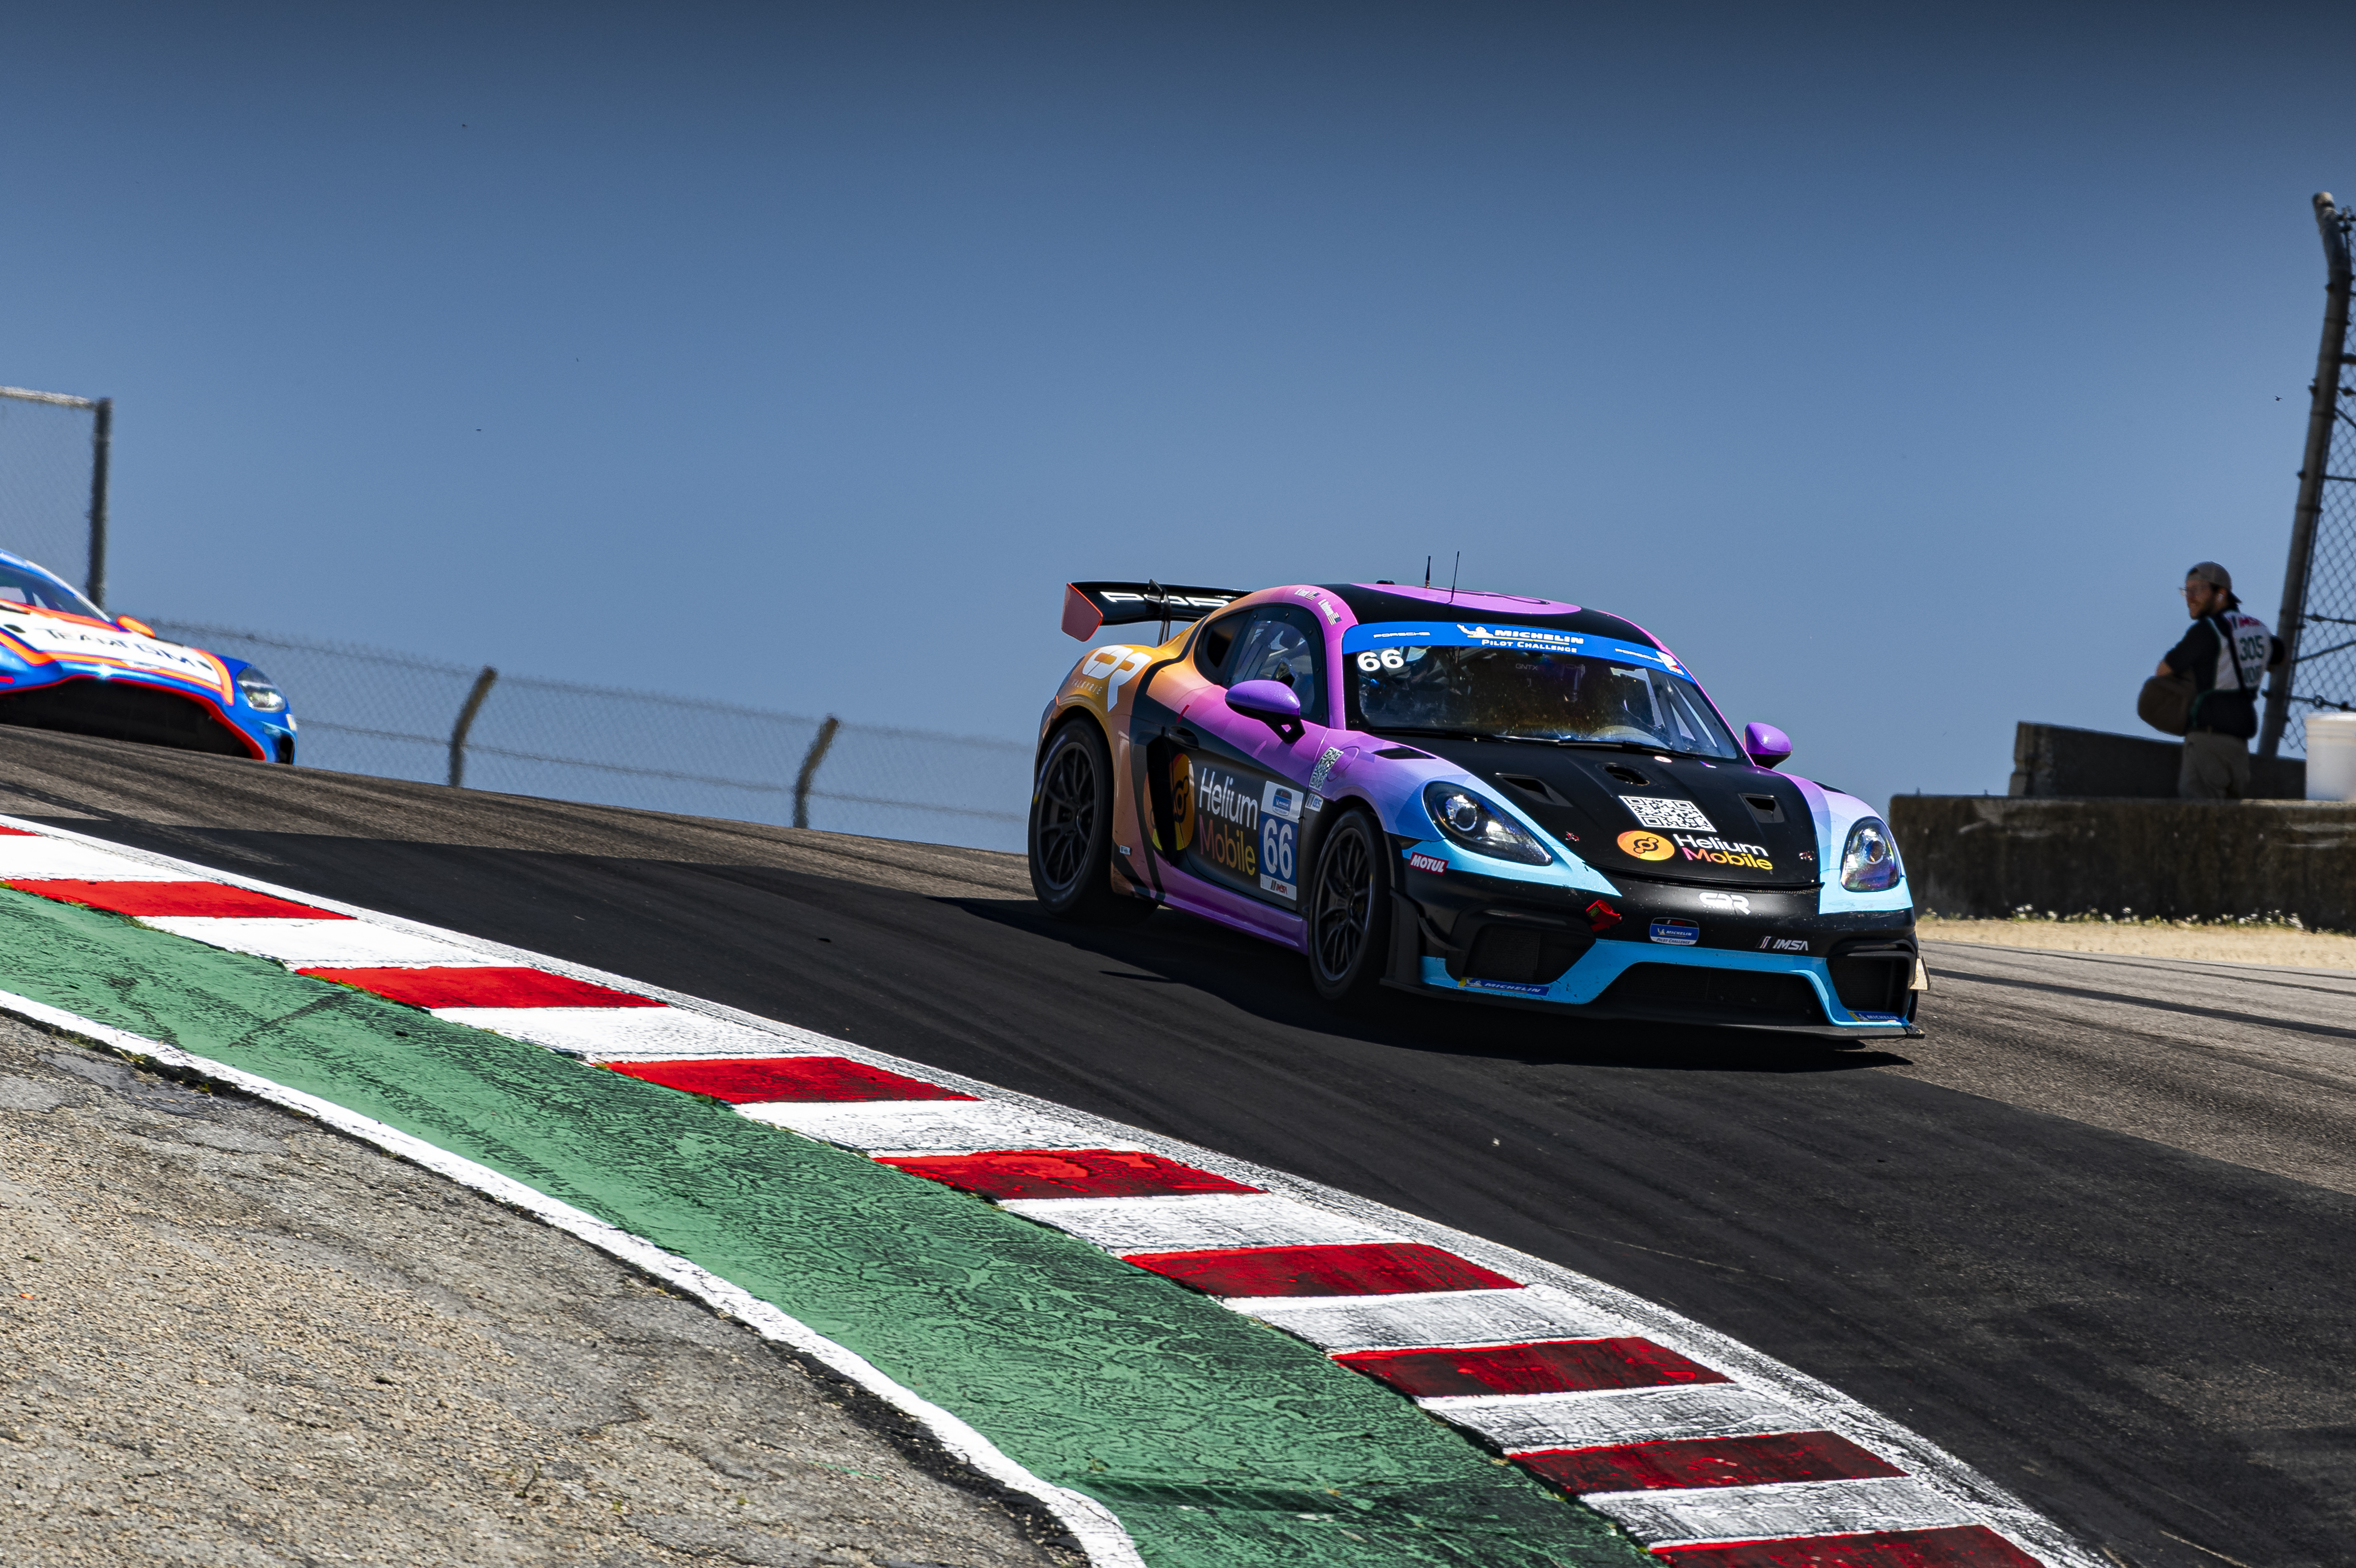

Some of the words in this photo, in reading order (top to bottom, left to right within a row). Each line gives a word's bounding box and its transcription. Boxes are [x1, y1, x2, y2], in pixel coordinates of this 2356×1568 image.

[1495, 629, 1584, 645] MICHELIN
[1517, 641, 1578, 653] CHALLENGE
[2239, 635, 2264, 660] 305
[1358, 649, 1404, 672] 66
[1071, 678, 1103, 695] VALKYRIE
[1199, 768, 1258, 830] Helium
[1312, 798, 1322, 809] GS
[1199, 814, 1256, 876] Mobile
[1263, 819, 1292, 879] 66
[1673, 834, 1769, 857] Helium
[1410, 854, 1445, 873] MOTUL
[1681, 847, 1773, 870] Mobile
[1773, 939, 1808, 951] IMSA
[1484, 983, 1541, 992] MICHELIN
